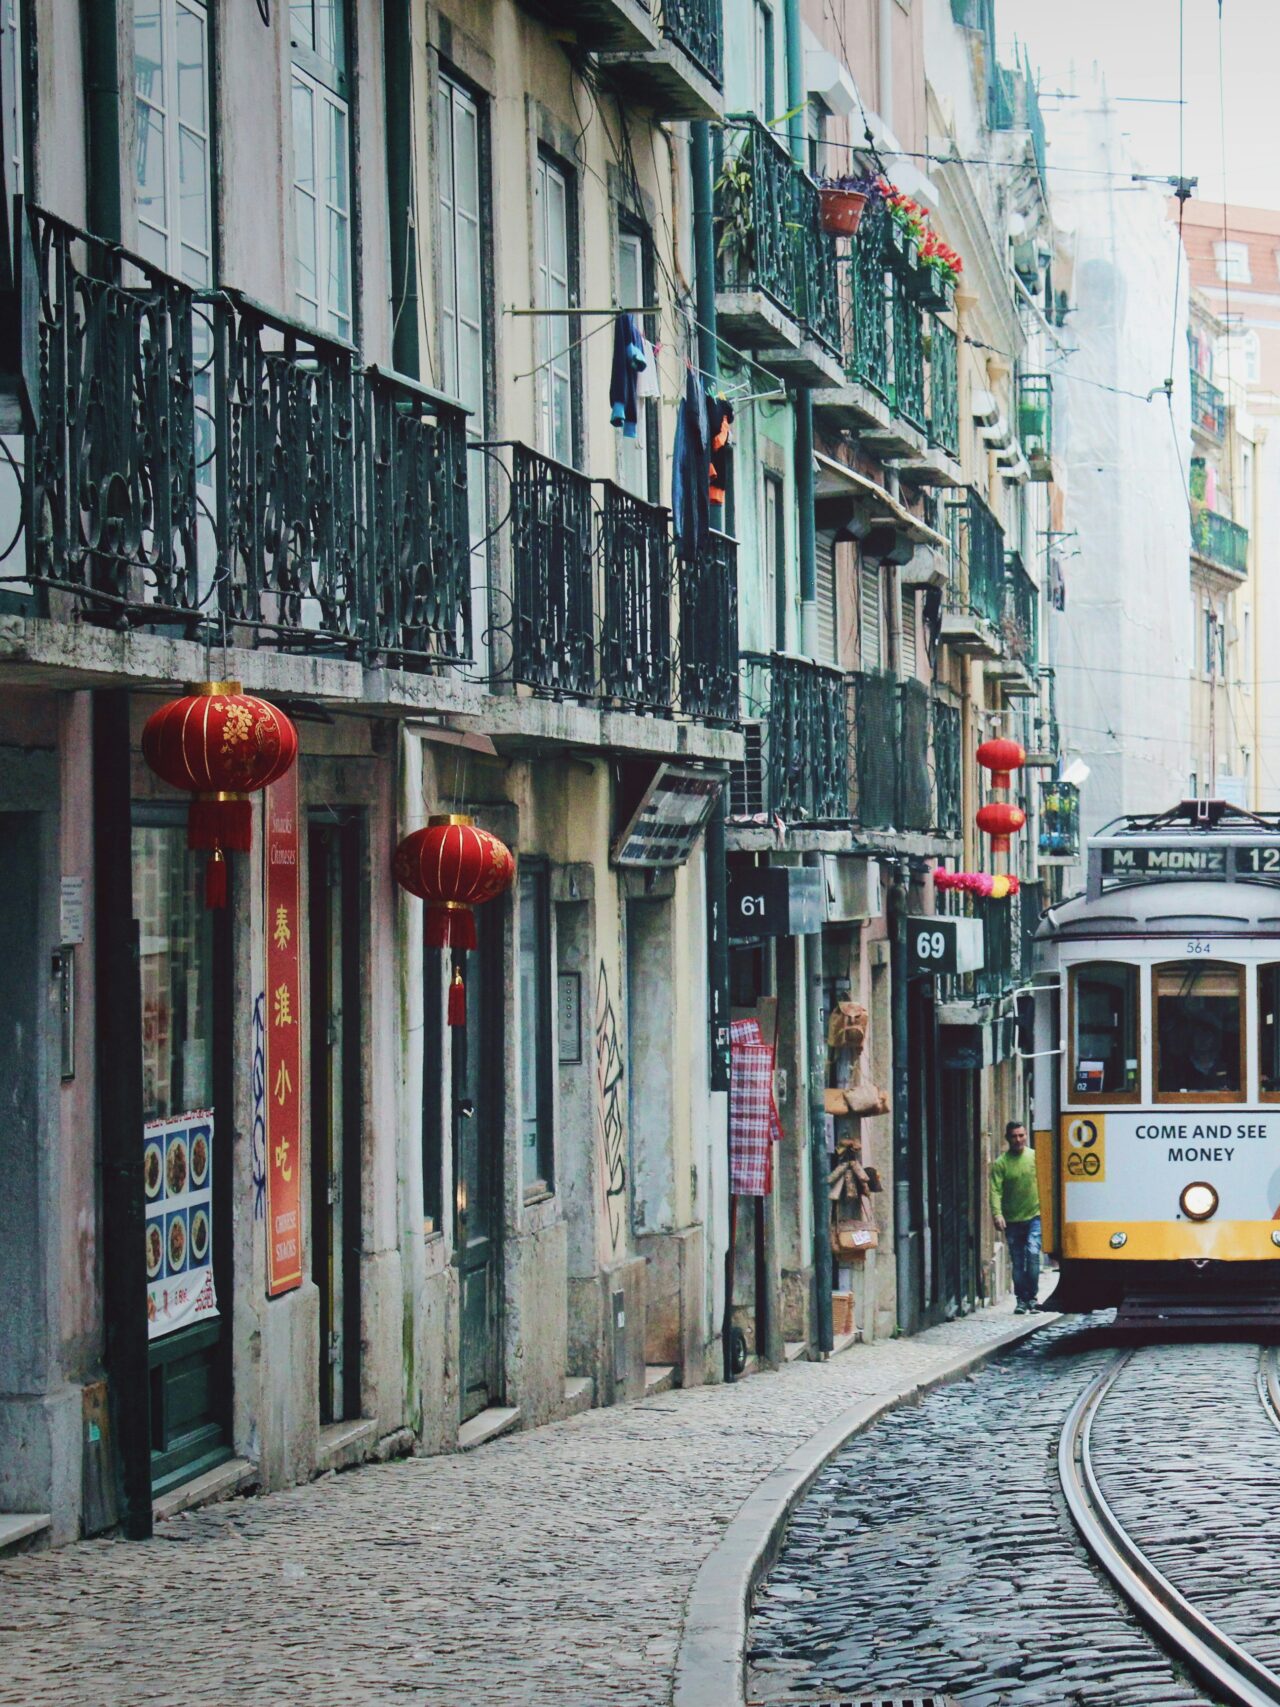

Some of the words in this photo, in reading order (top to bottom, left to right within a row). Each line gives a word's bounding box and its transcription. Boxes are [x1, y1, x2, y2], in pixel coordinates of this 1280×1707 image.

[1113, 850, 1137, 866] M.
[1148, 852, 1224, 869] MONIZ
[1249, 849, 1280, 872] 12
[741, 895, 765, 916] 61
[916, 931, 945, 959] 69
[1186, 942, 1211, 954] 564
[1135, 1125, 1188, 1140] COME
[1192, 1125, 1232, 1140] AND
[1237, 1125, 1268, 1139] SEE
[1168, 1148, 1235, 1162] MONEY
